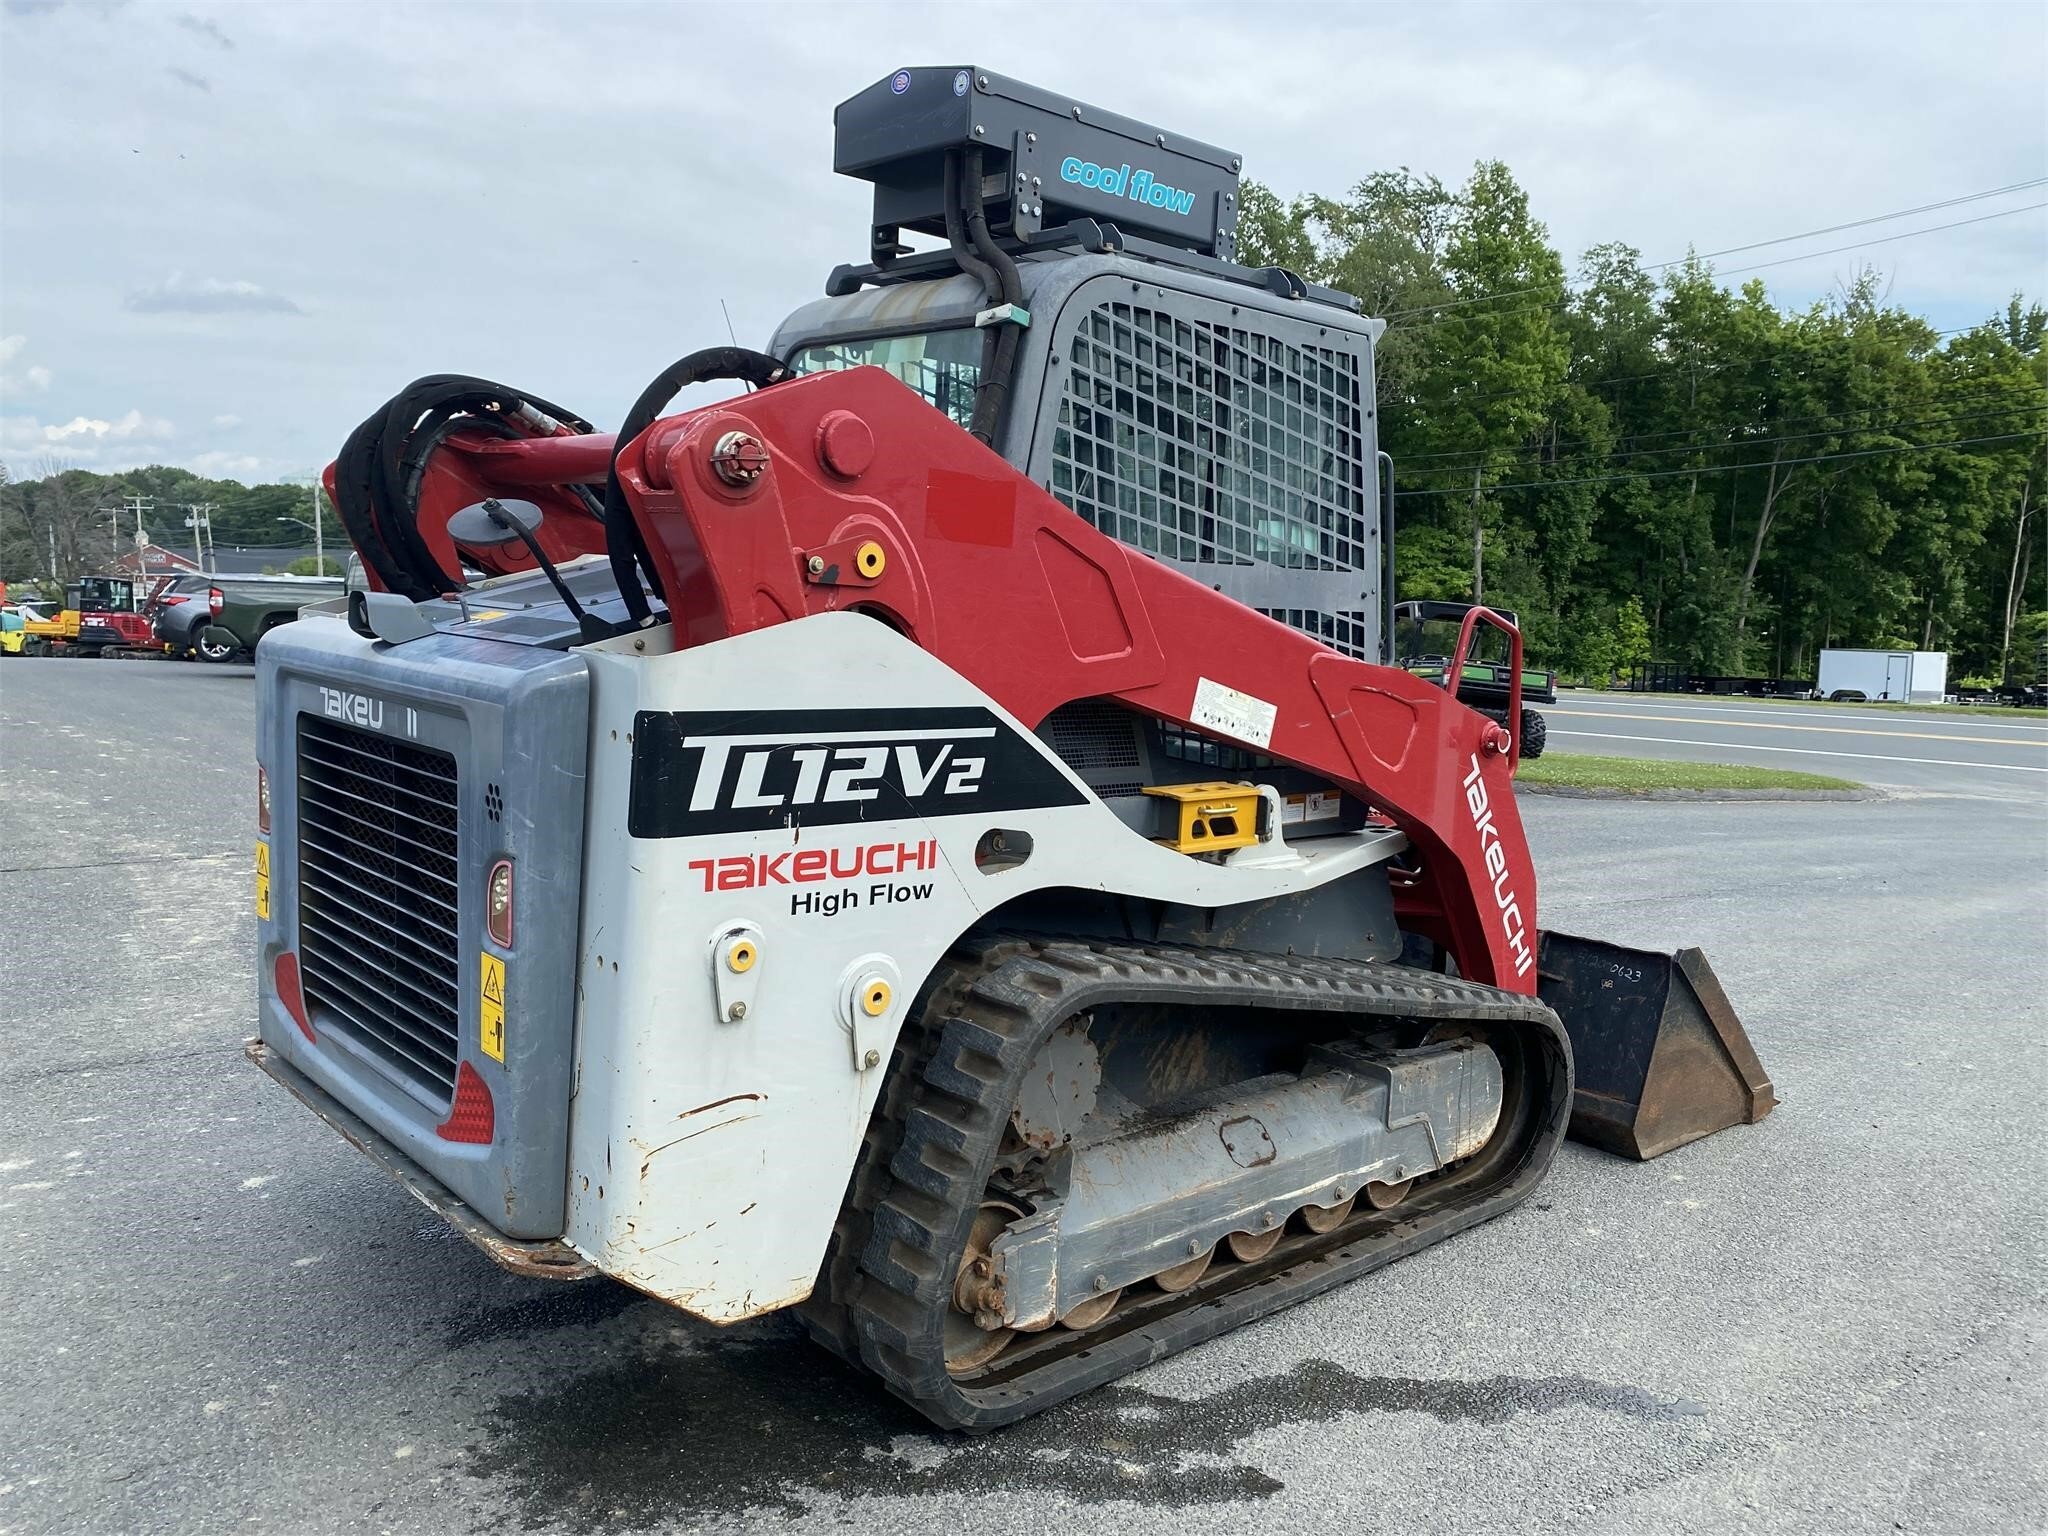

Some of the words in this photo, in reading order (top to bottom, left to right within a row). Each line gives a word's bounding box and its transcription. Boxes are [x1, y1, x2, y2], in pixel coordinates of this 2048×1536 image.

[1061, 157, 1130, 197] cool
[1129, 169, 1195, 215] flow
[682, 727, 997, 812] TL12V2
[688, 839, 937, 893] TAKEUCHI
[1463, 752, 1533, 978] TAKEUCHI
[790, 887, 858, 917] High
[869, 883, 934, 907] Flow
[1609, 963, 1642, 983] 0623
